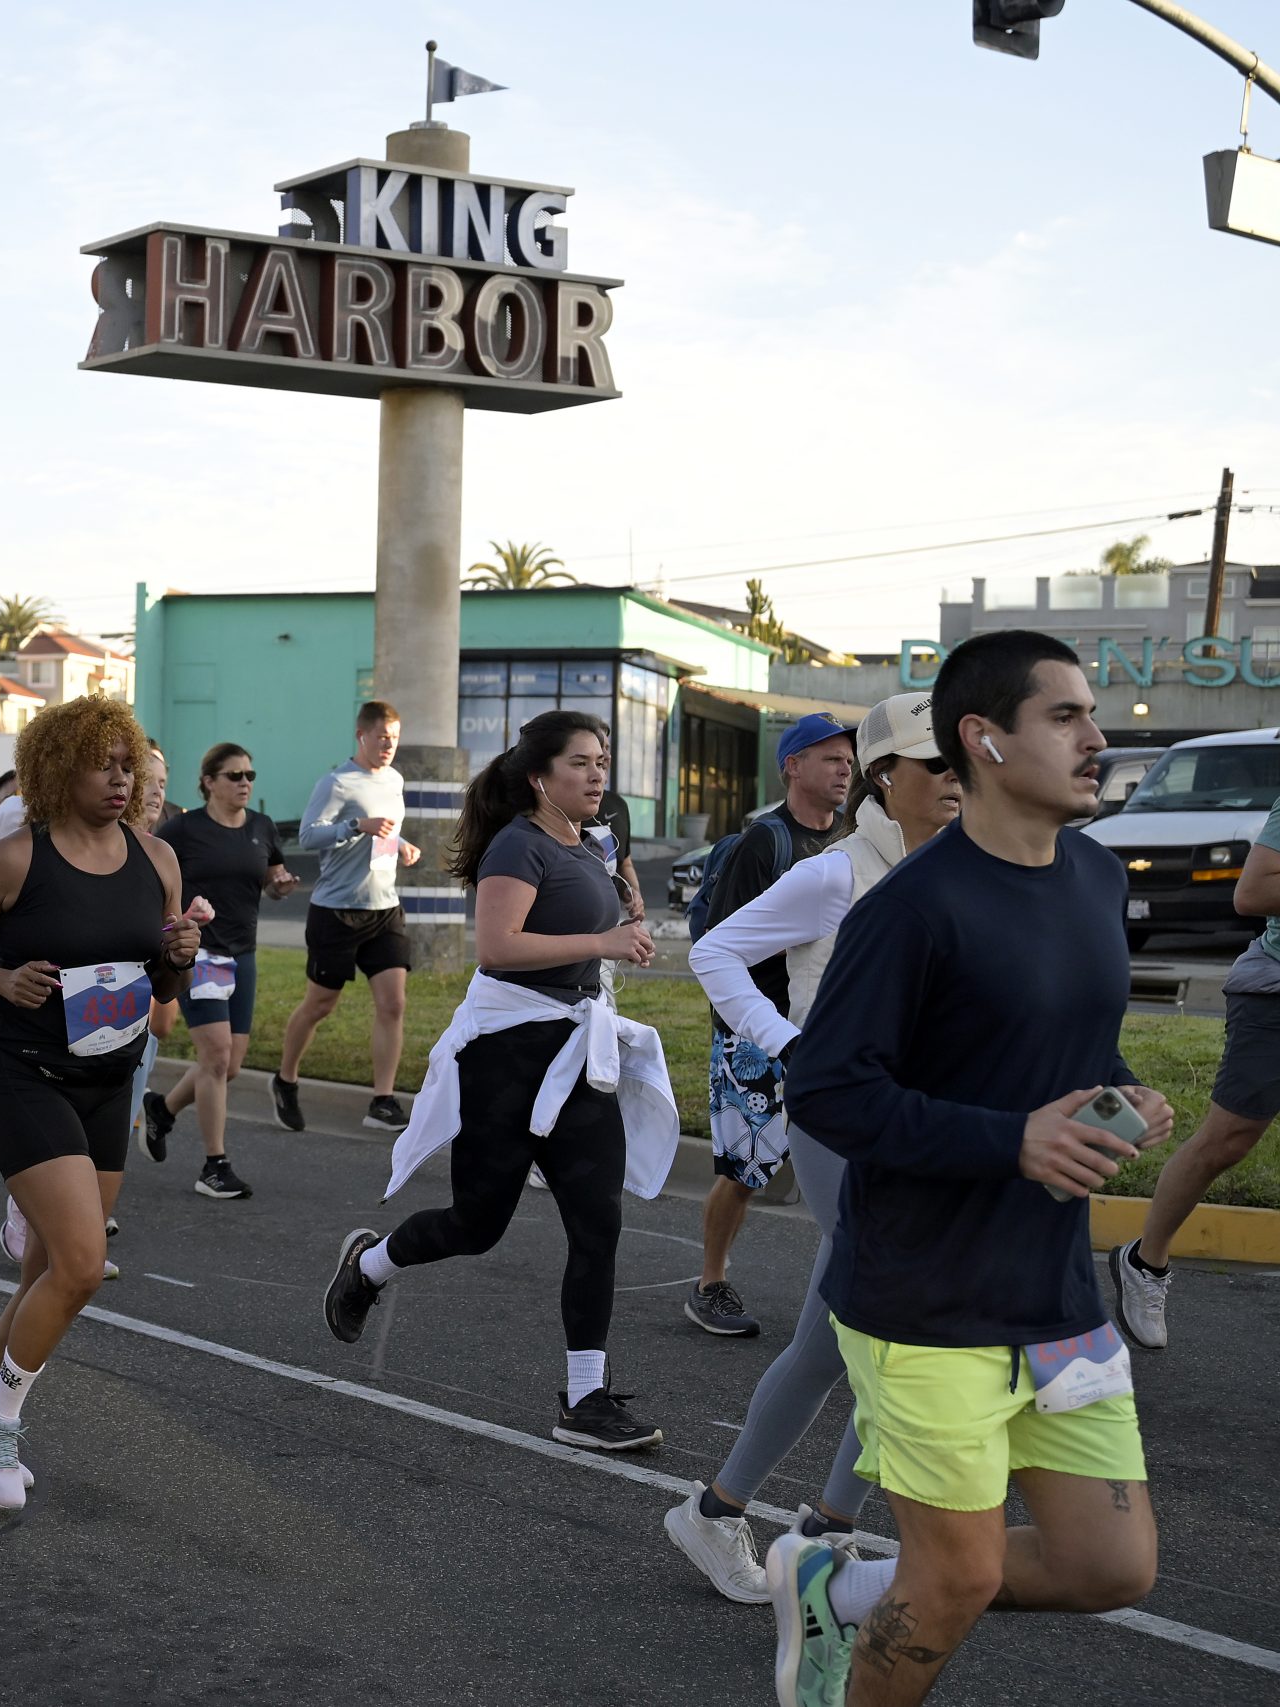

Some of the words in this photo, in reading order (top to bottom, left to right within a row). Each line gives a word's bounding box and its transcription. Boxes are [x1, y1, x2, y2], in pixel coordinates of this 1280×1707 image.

[349, 166, 568, 271] KING
[150, 231, 615, 390] HARBOR
[82, 991, 137, 1026] 434
